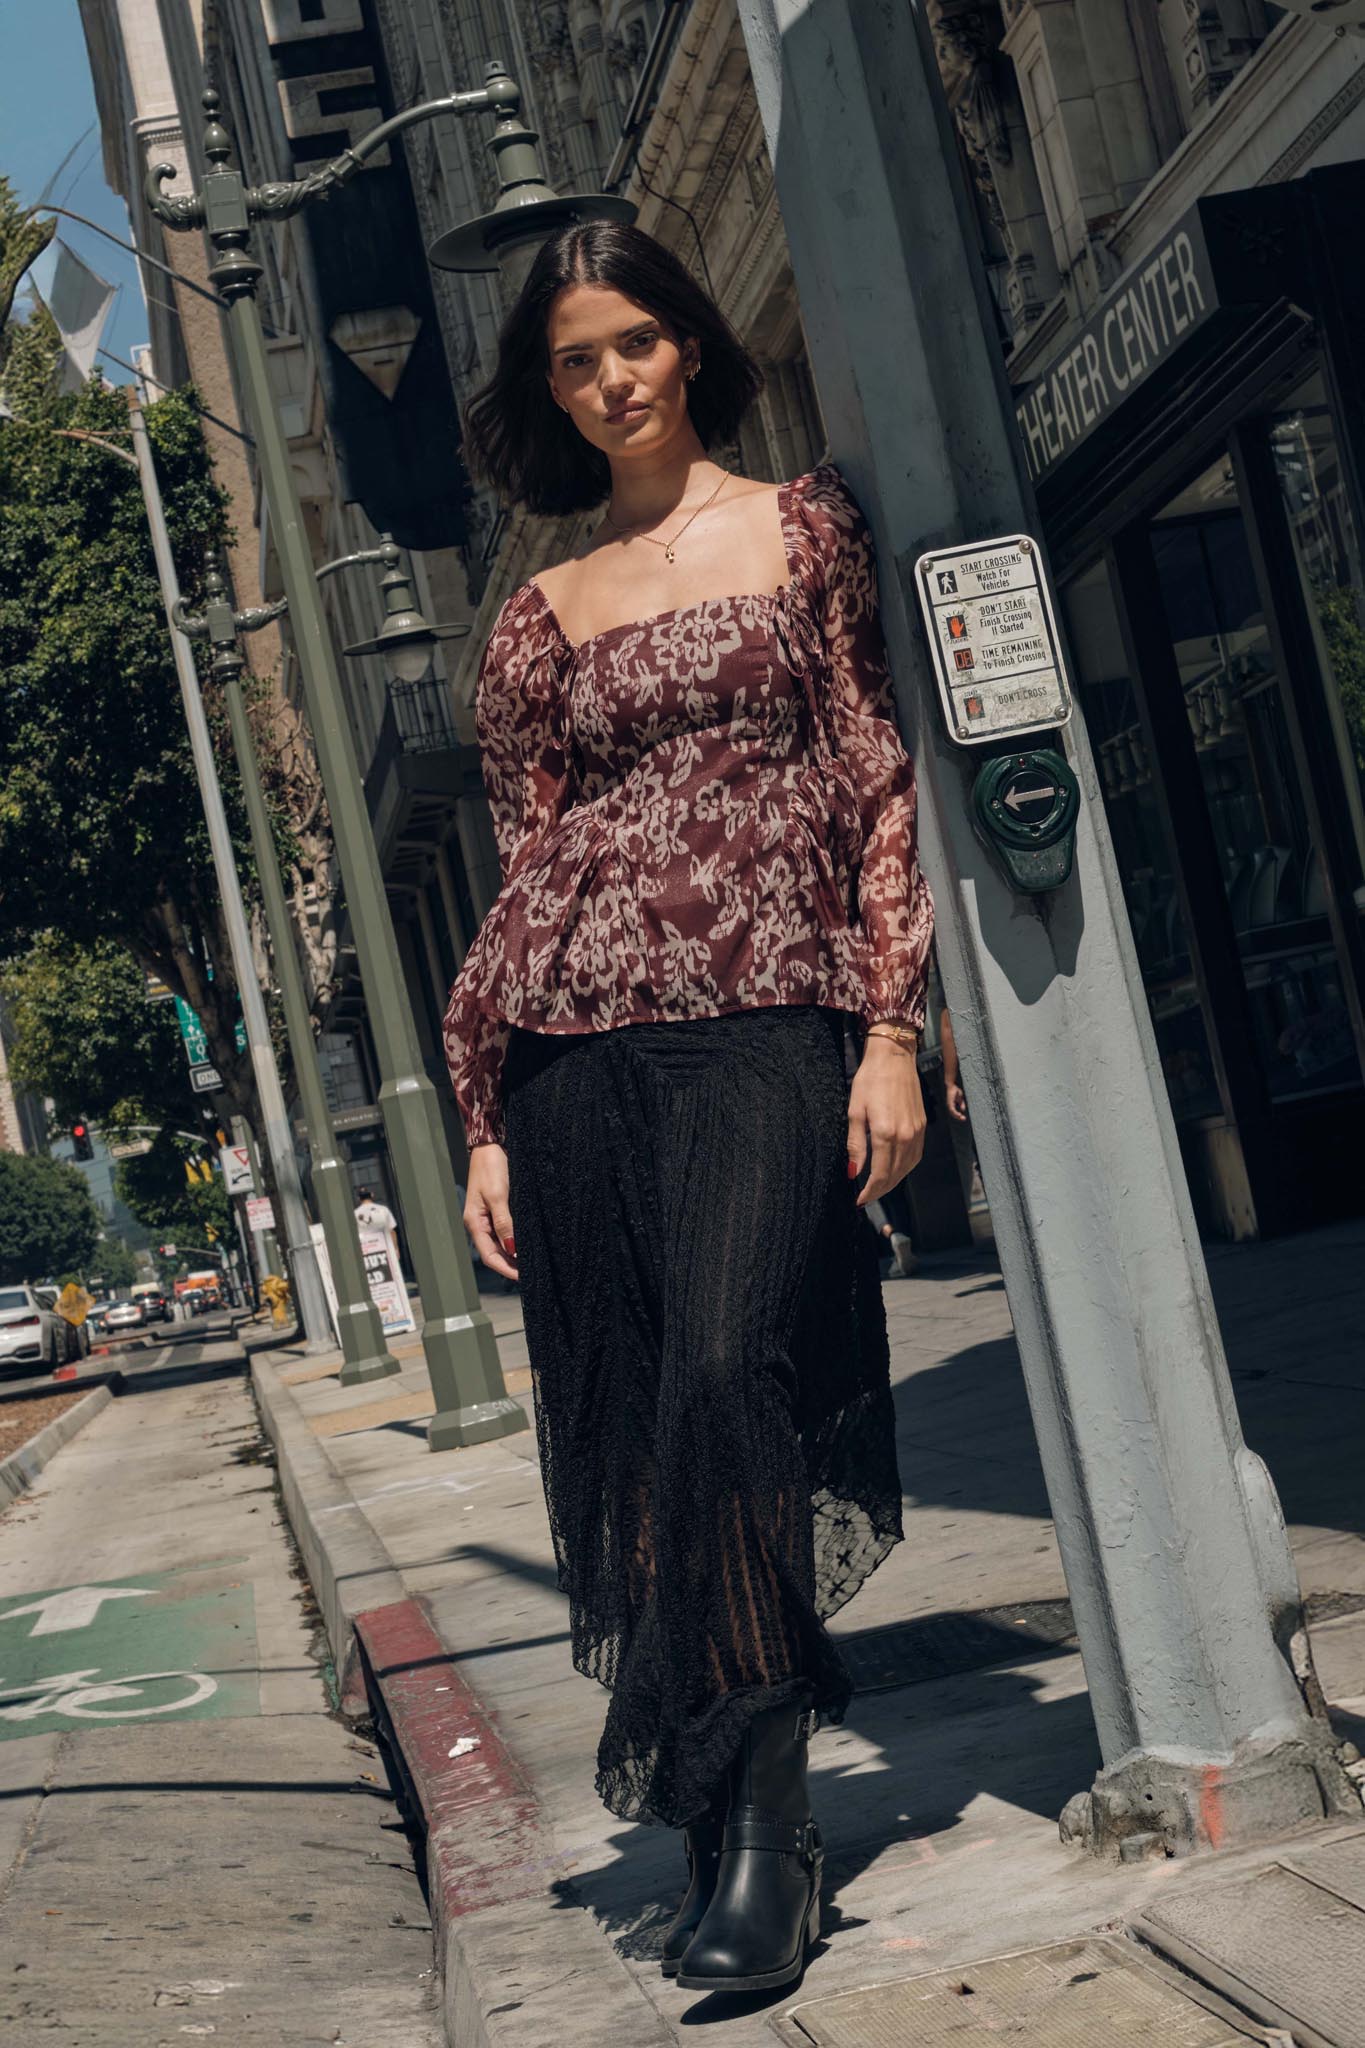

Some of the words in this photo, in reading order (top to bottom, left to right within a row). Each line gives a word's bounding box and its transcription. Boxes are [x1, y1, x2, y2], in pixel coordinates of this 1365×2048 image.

[1103, 231, 1205, 391] CENTER
[960, 560, 982, 573] START
[985, 552, 1022, 568] CROSSING
[976, 570, 997, 583] Watch
[999, 568, 1010, 578] For
[981, 579, 1010, 592] Vehicles
[980, 602, 1002, 616] DON'T
[1005, 598, 1026, 611] START
[980, 616, 1001, 628] Finish
[1003, 610, 1032, 624] Crossing
[992, 625, 998, 635] If
[1000, 621, 1025, 634] Started
[981, 648, 1000, 660] TIME
[1001, 638, 1043, 654] REMAINING
[983, 660, 992, 670] To
[993, 656, 1015, 668] Finish
[1017, 650, 1047, 665] Crossing
[998, 692, 1021, 705] DON'T
[1023, 686, 1048, 700] CROSS
